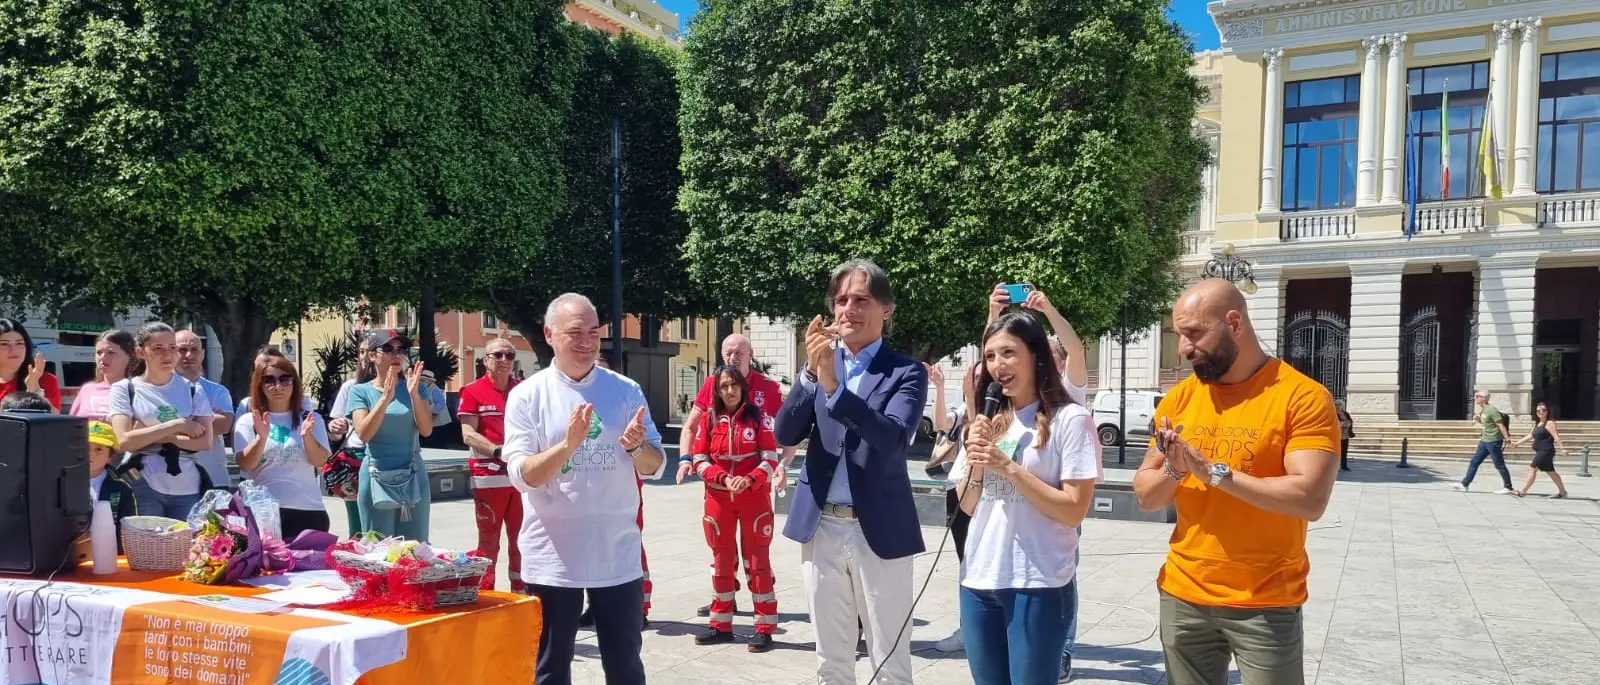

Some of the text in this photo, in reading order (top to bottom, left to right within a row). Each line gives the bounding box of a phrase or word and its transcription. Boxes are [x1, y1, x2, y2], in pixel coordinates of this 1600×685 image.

[1275, 0, 1466, 33] AMMINISTRAZIONE
[572, 451, 616, 466] CHOPS
[144, 614, 171, 629] "Non
[185, 619, 206, 633] mai
[210, 622, 249, 640] troppo
[144, 631, 168, 645] tardi
[172, 634, 192, 647] con
[203, 636, 254, 656] bambini,
[145, 646, 247, 670] le loro stesse vite
[145, 663, 170, 677] sono
[174, 665, 193, 680] dei
